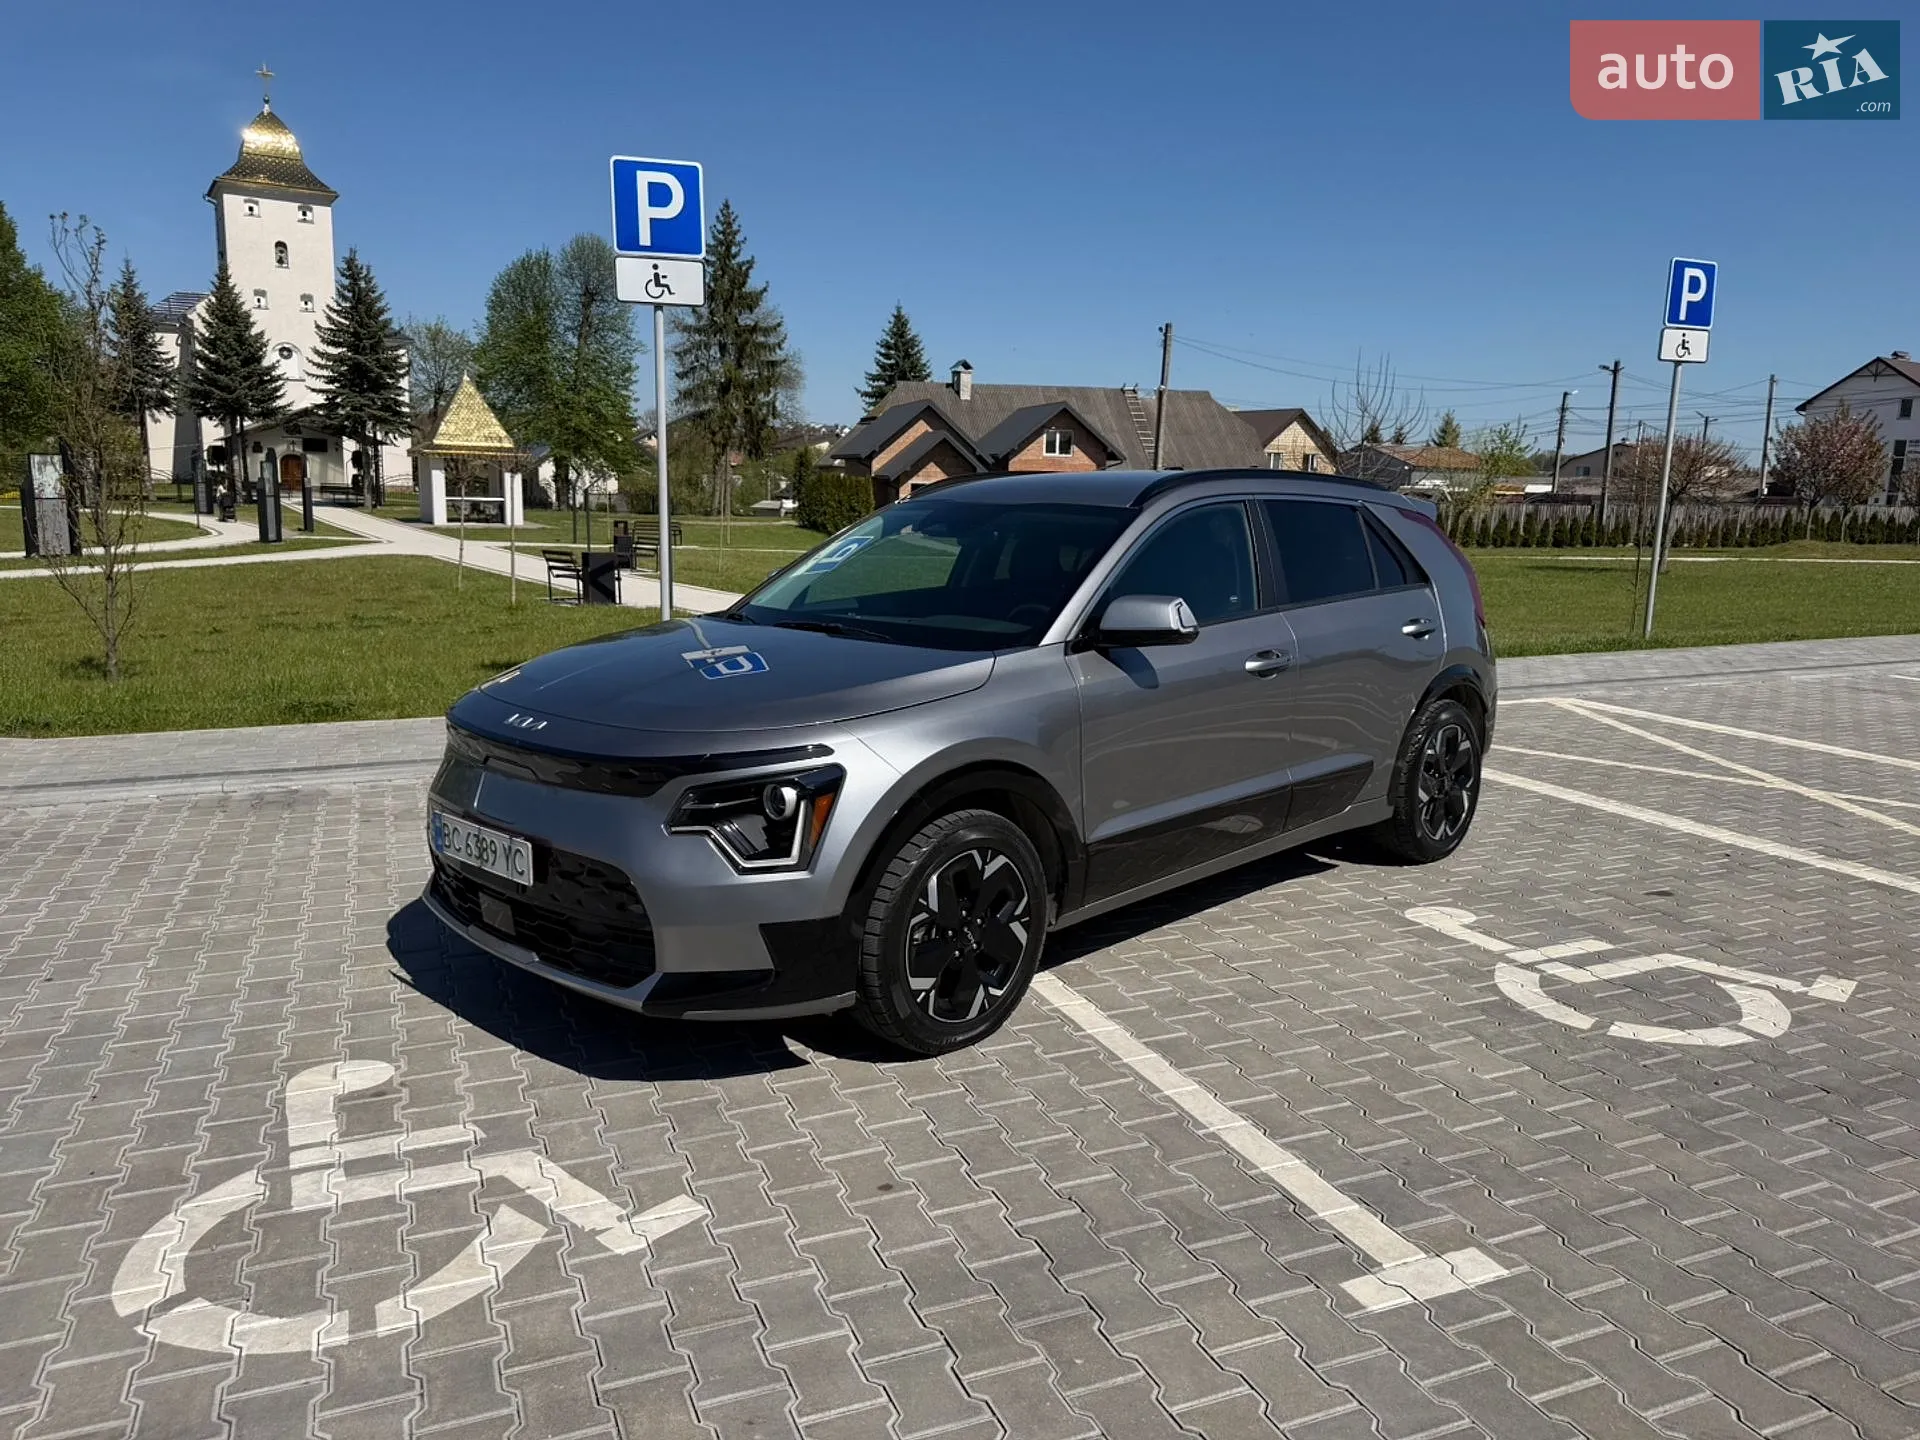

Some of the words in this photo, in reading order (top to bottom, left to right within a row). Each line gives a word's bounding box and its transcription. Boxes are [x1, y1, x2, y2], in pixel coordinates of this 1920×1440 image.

[636, 170, 684, 246] P
[1679, 267, 1707, 320] P
[443, 823, 462, 852] BC
[466, 831, 498, 866] 6389
[502, 841, 525, 876] YC
